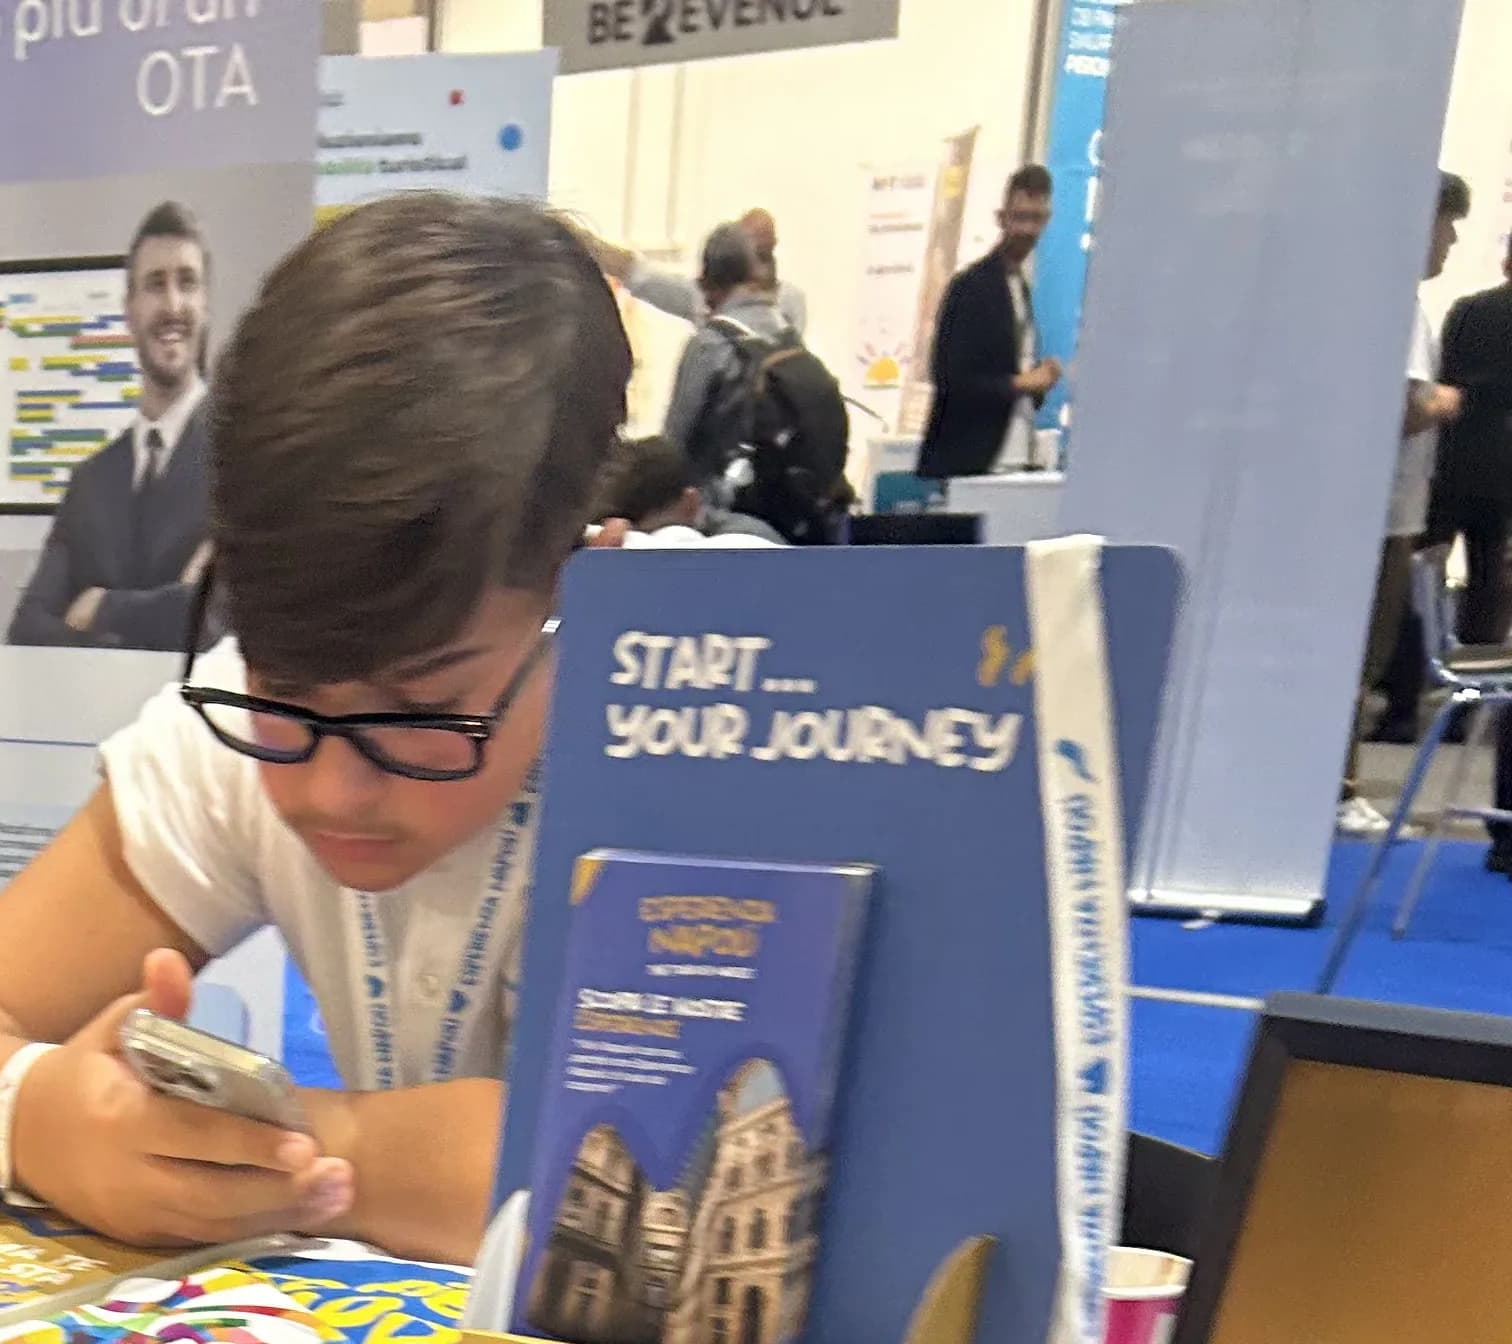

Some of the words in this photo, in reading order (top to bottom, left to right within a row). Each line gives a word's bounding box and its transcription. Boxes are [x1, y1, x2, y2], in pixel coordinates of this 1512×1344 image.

[135, 42, 260, 116] OTA
[610, 631, 818, 693] START...
[604, 703, 751, 760] YOUR
[751, 704, 1024, 773] JOURNEY
